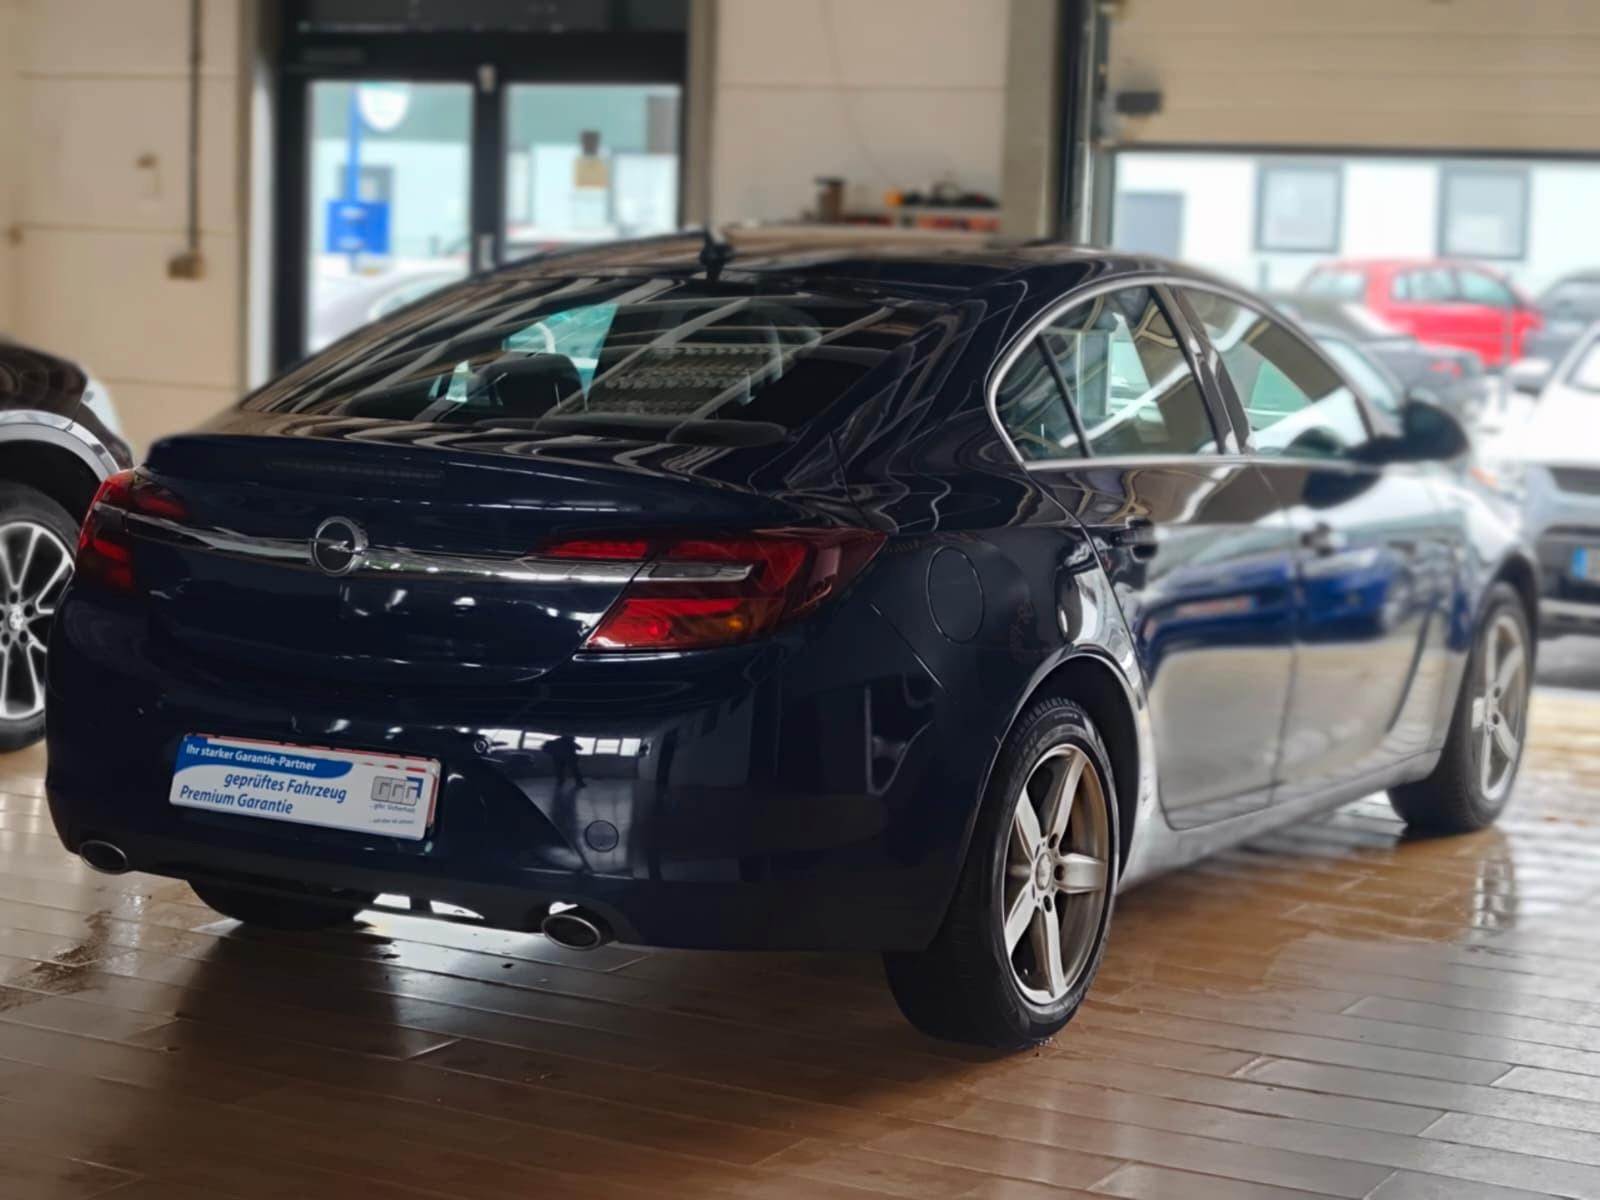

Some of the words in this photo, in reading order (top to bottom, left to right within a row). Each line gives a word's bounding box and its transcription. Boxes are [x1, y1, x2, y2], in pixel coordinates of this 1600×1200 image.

[186, 744, 200, 754] Ihr
[201, 748, 234, 760] starker
[235, 751, 316, 771] Garantie-Partner
[180, 785, 234, 806] Premium
[237, 794, 293, 814] Garantie
[224, 773, 284, 792] geprüftes
[286, 779, 347, 804] Fahrzeug
